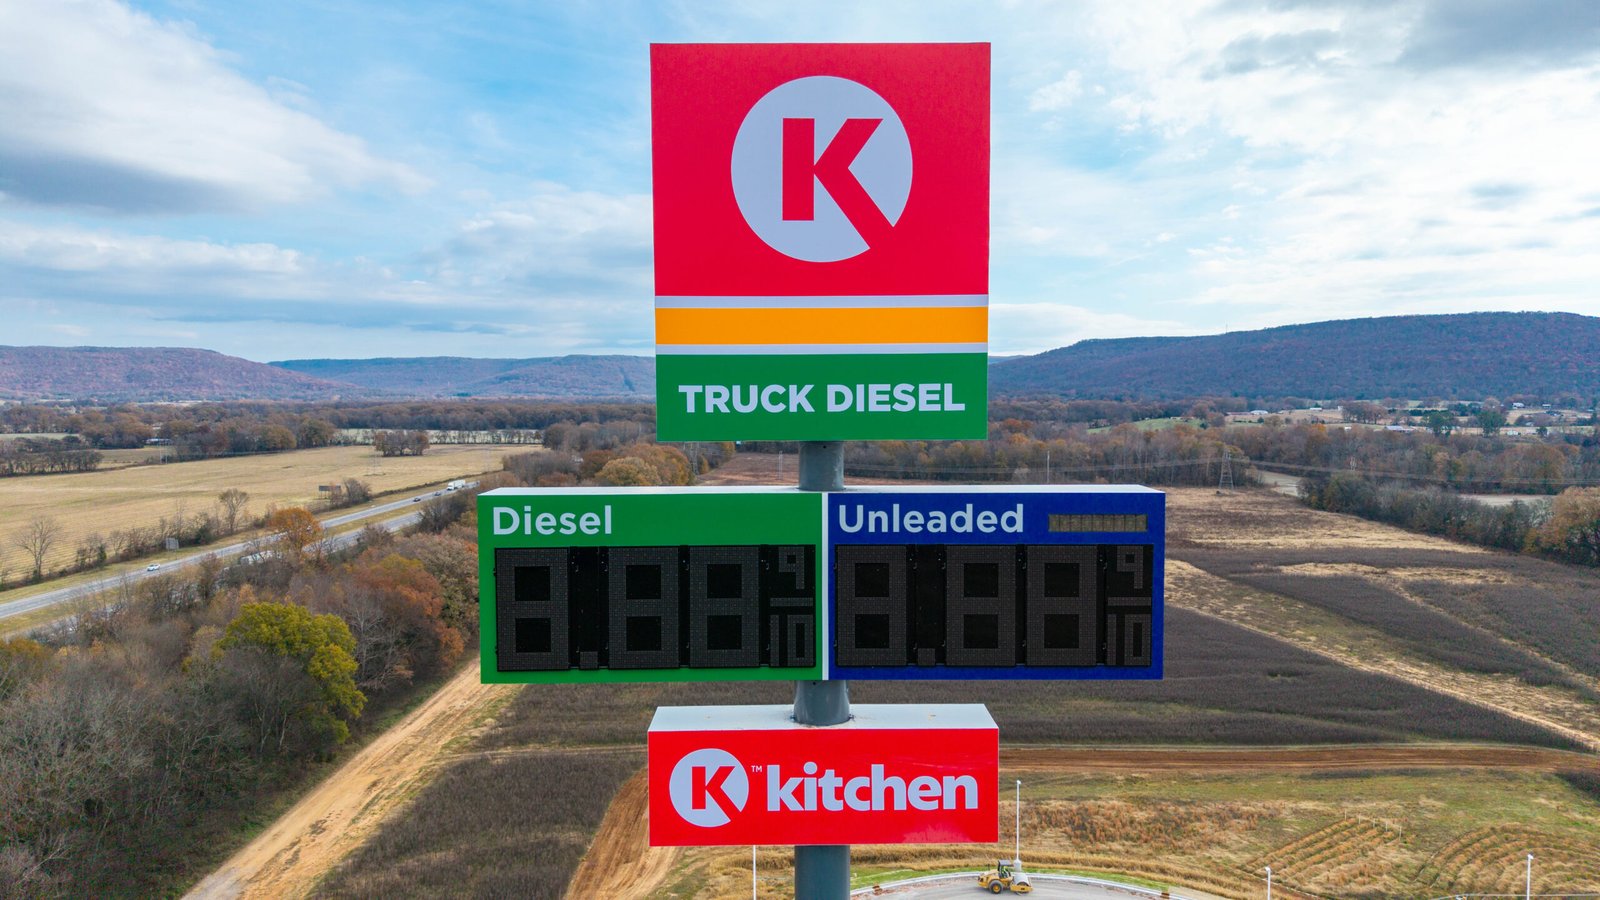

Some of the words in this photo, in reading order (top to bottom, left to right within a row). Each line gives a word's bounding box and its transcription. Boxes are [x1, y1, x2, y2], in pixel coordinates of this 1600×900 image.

[782, 117, 893, 247] K
[678, 384, 815, 413] TRUCK
[827, 383, 965, 412] DIESEL
[493, 505, 612, 535] Diesel
[839, 503, 1023, 533] Unleaded
[691, 766, 741, 823] K
[767, 761, 978, 812] kitchen
